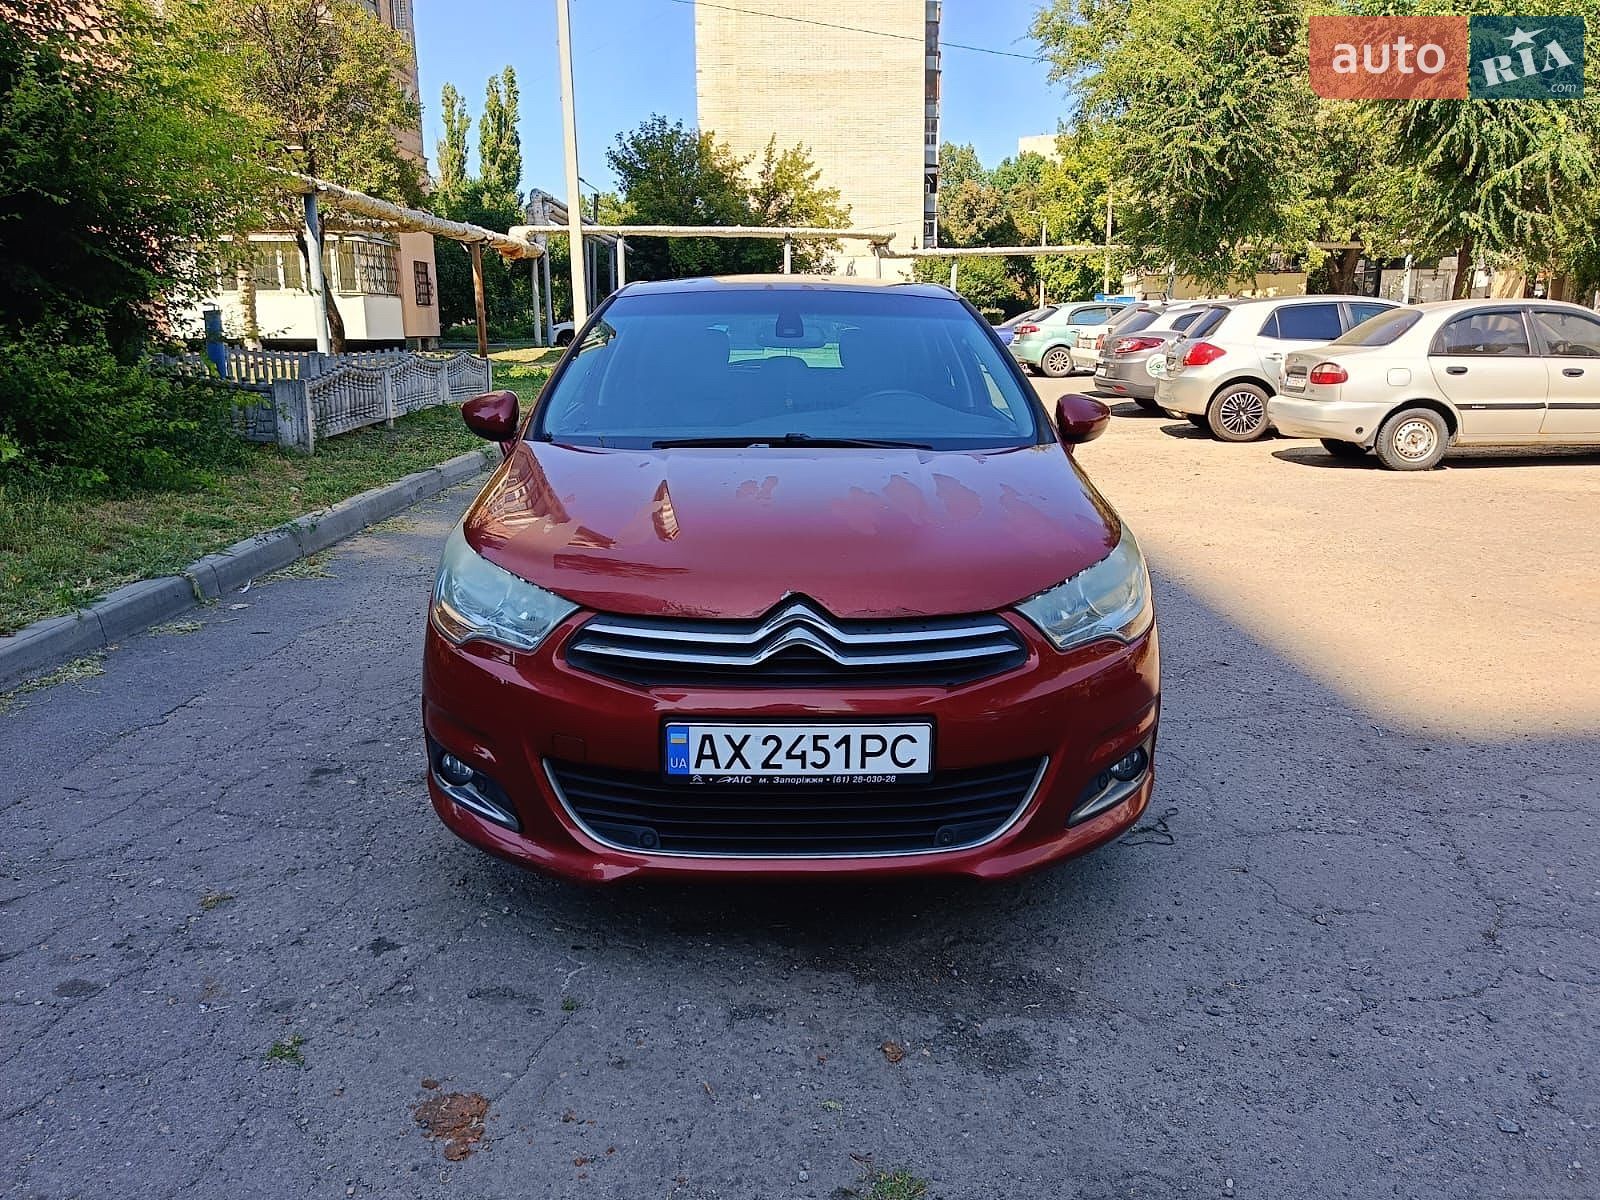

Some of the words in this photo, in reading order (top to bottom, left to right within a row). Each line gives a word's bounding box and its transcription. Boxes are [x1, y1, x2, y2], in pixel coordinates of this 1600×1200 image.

[670, 757, 688, 769] UA
[694, 734, 752, 770] AX
[760, 734, 851, 770] 2451
[859, 733, 919, 770] PC
